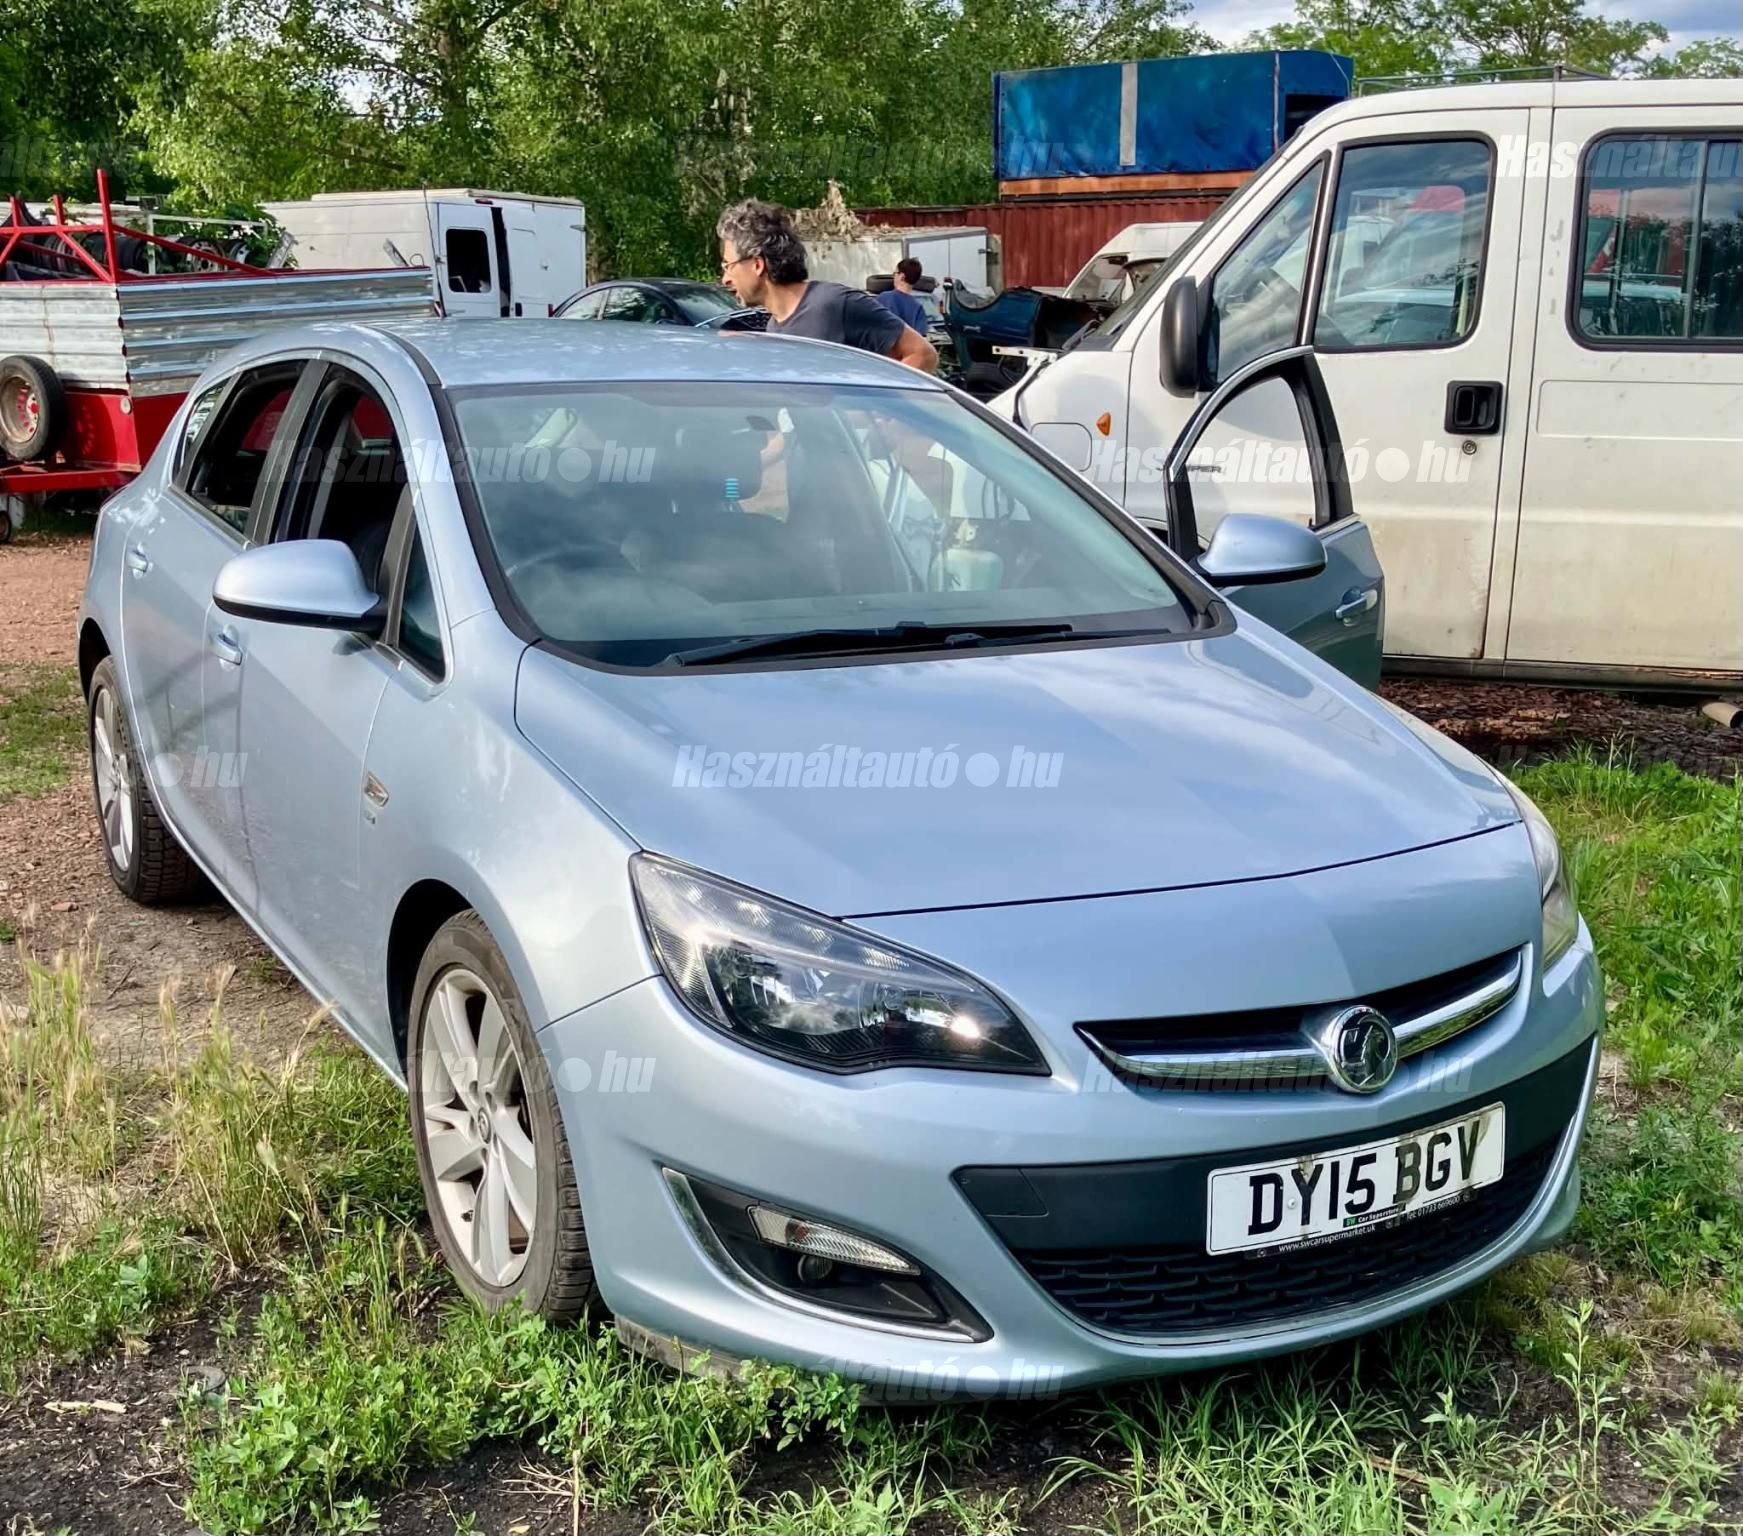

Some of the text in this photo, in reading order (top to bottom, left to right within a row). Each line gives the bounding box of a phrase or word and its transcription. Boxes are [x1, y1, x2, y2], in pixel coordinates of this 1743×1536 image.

[1248, 1119, 1480, 1236] DY15 BGV
[1358, 1215, 1369, 1223] Car
